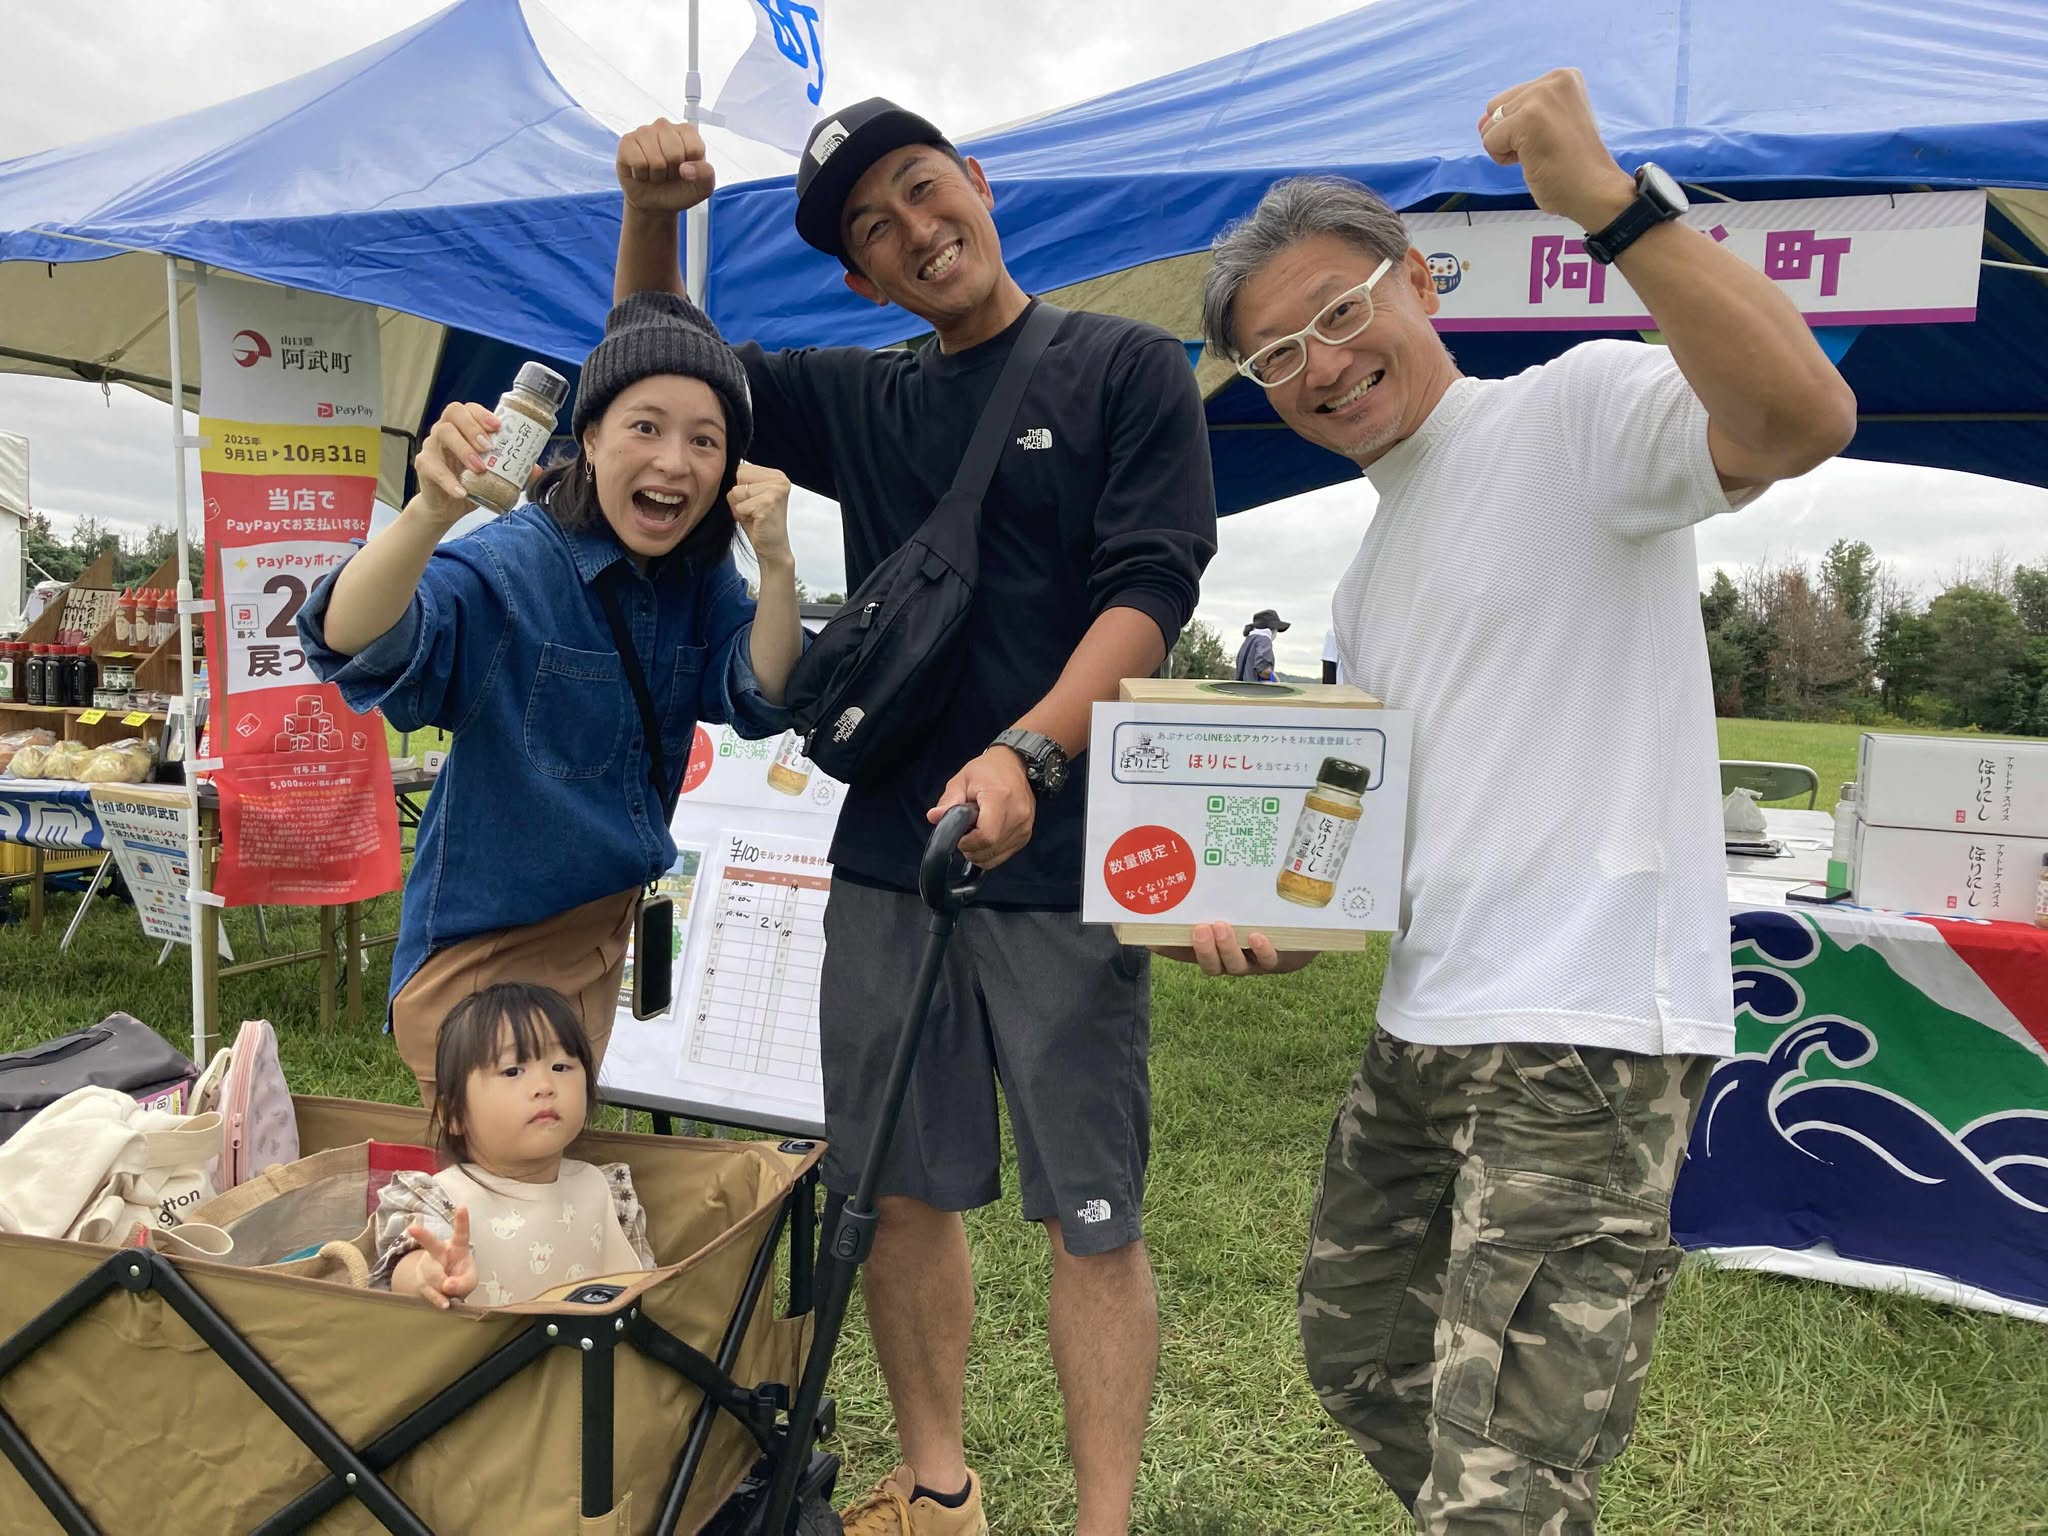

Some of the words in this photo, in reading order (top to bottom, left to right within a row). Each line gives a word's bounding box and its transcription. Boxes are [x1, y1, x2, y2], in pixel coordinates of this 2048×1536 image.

[1529, 230, 1851, 304] 阿町
[281, 336, 313, 347] 山口県
[281, 348, 352, 374] 阿武町
[335, 405, 374, 418] PayPay
[224, 434, 261, 446] 2025年
[502, 421, 533, 472] ほりにし
[1016, 435, 1042, 445] NORTH
[1023, 442, 1042, 450] FACE
[224, 447, 268, 462] 9月1日
[283, 444, 366, 464] 10月31日
[268, 488, 335, 511] 当店で
[226, 518, 366, 534] PayPayでお支払いすると
[263, 574, 330, 637] 2
[237, 630, 256, 639] 最大
[832, 716, 854, 743] NORTH
[834, 713, 849, 728] THE
[842, 722, 857, 742] FACE
[1120, 757, 1170, 770] ほりにし
[2003, 756, 2014, 794] アウトドア
[1976, 757, 1996, 821] ほりにし
[2001, 795, 2011, 821] スパイス
[1230, 827, 1254, 836] LINE
[1308, 817, 1334, 873] ほりにし
[1108, 840, 1178, 875] 数量限定！
[1994, 844, 2005, 880] アウトドア
[1125, 872, 1187, 900] なくなり次第
[1966, 845, 1986, 907] ほりにし
[1149, 890, 1168, 905] 終了
[1992, 882, 2001, 908] スパイス
[760, 916, 770, 929] 2
[1077, 1206, 1100, 1218] NORTH
[1086, 1200, 1100, 1208] THE
[1084, 1214, 1100, 1225] FACE
